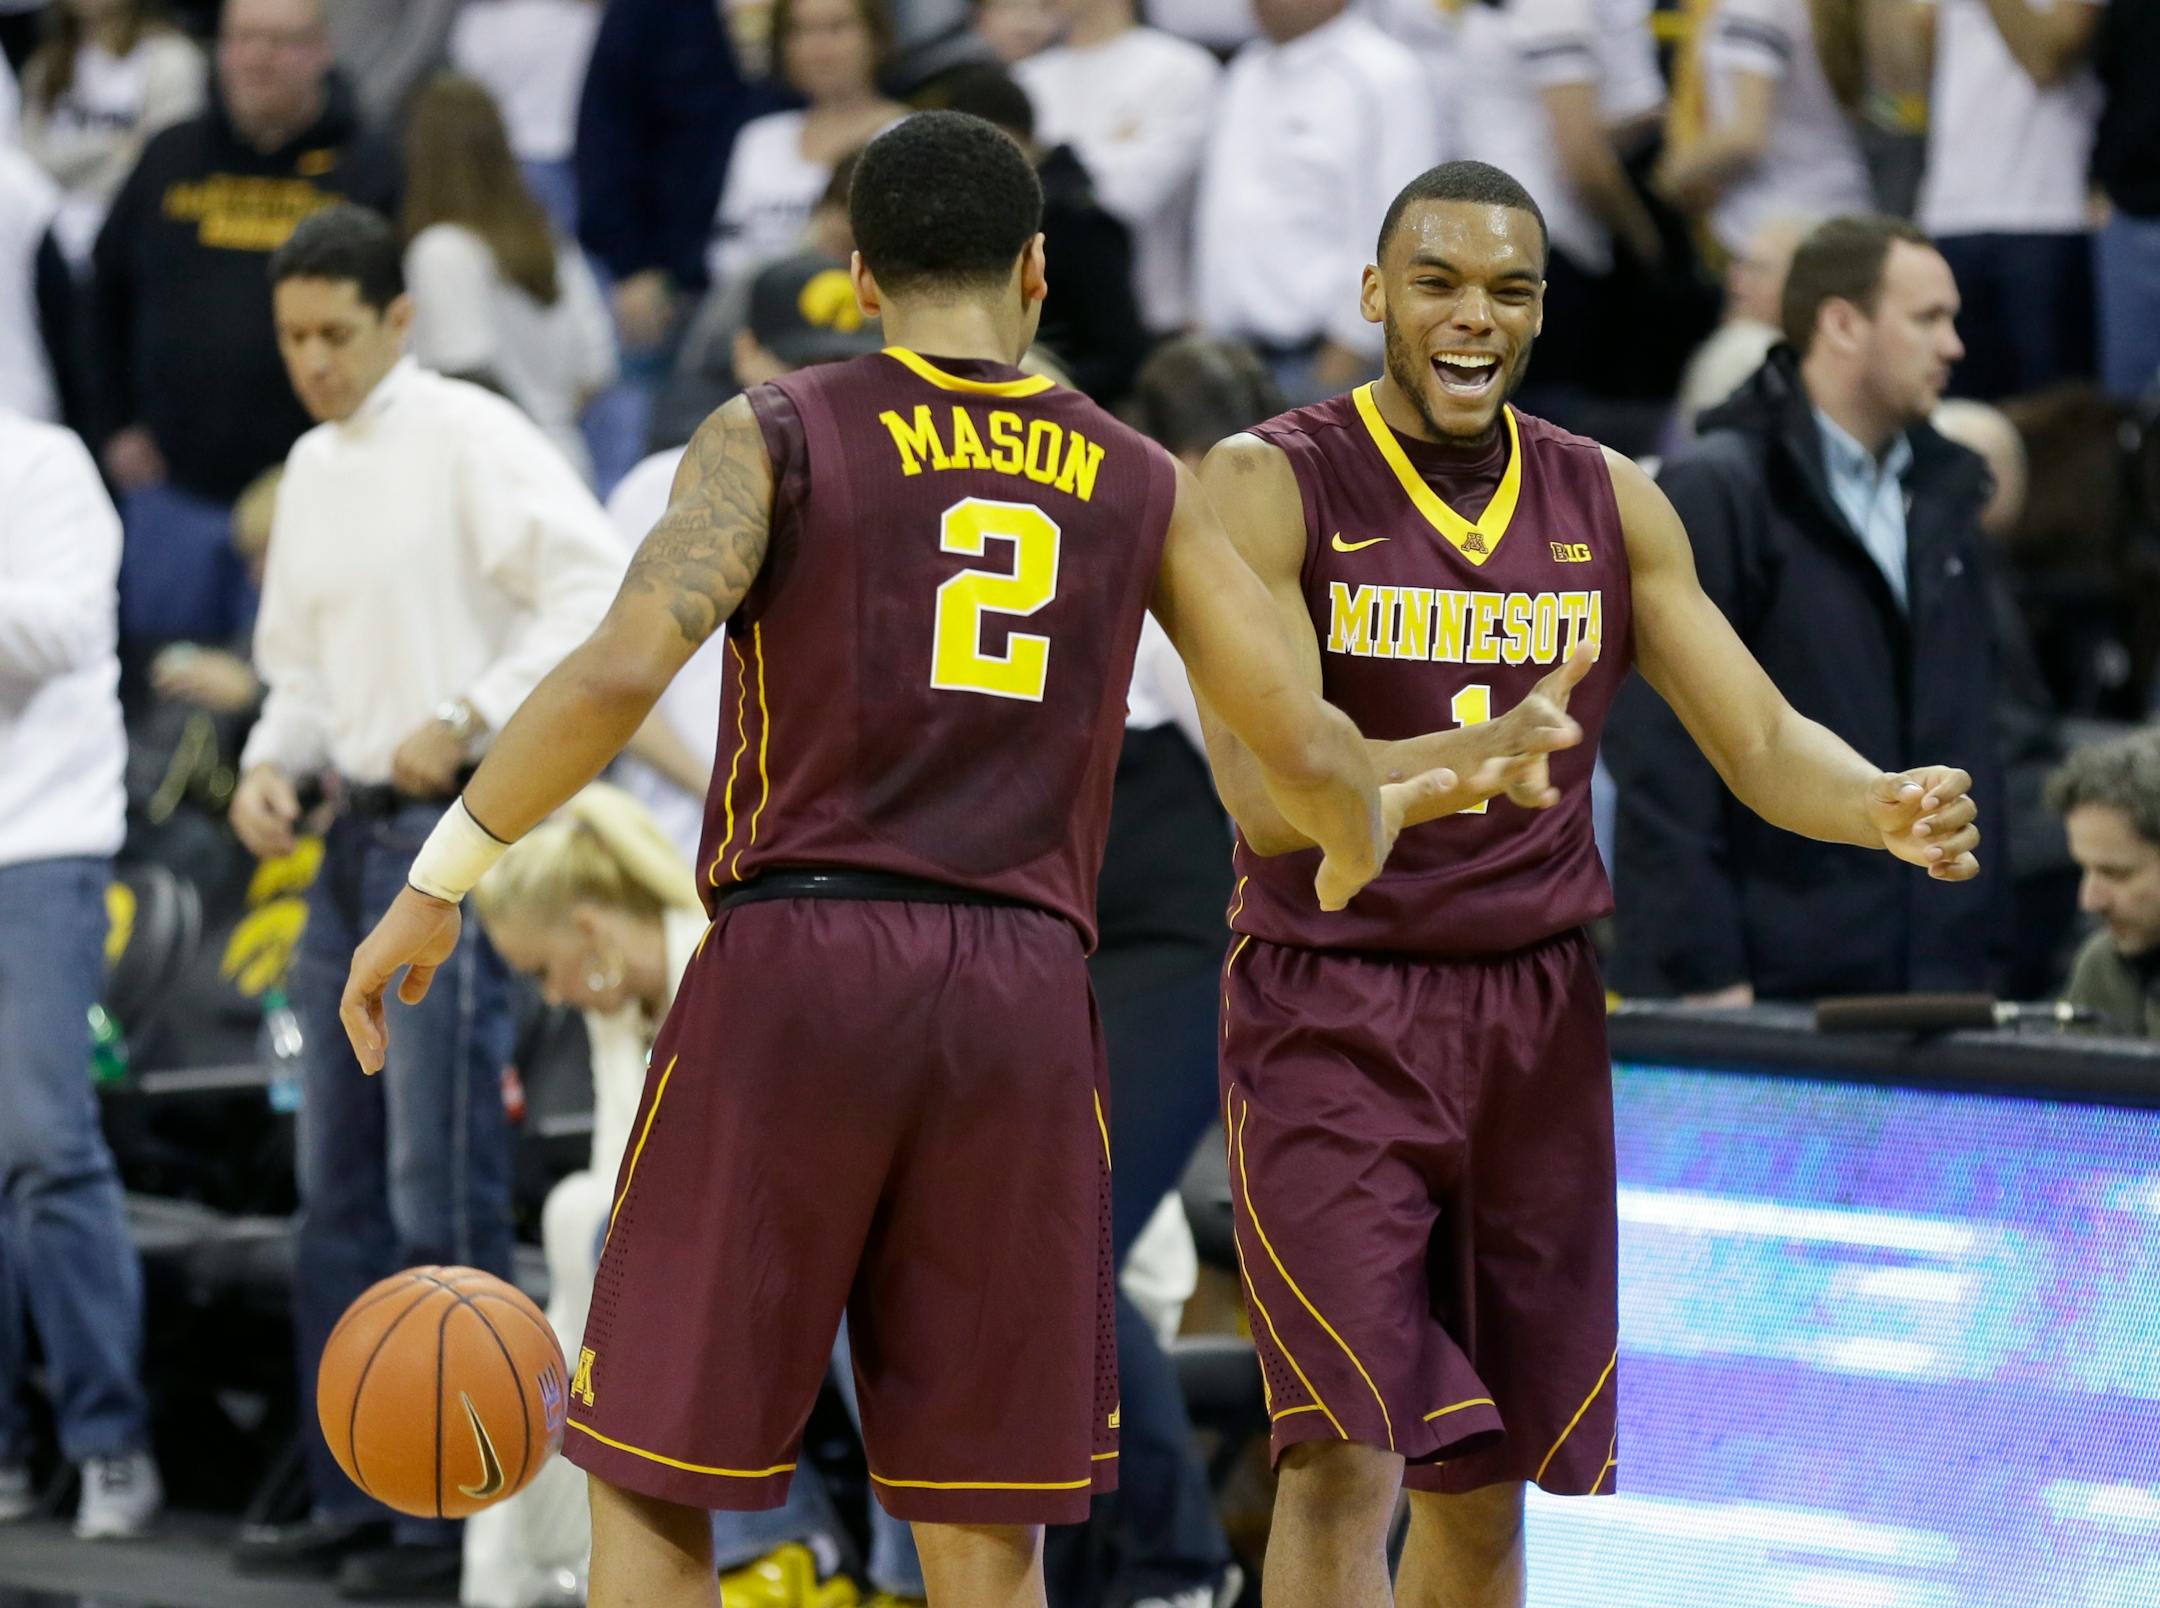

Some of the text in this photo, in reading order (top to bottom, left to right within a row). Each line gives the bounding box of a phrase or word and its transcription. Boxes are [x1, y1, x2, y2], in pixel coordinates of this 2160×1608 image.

[879, 405, 1105, 502] MASON
[930, 496, 1061, 702] 2
[1327, 581, 1602, 665] MINNESOTA
